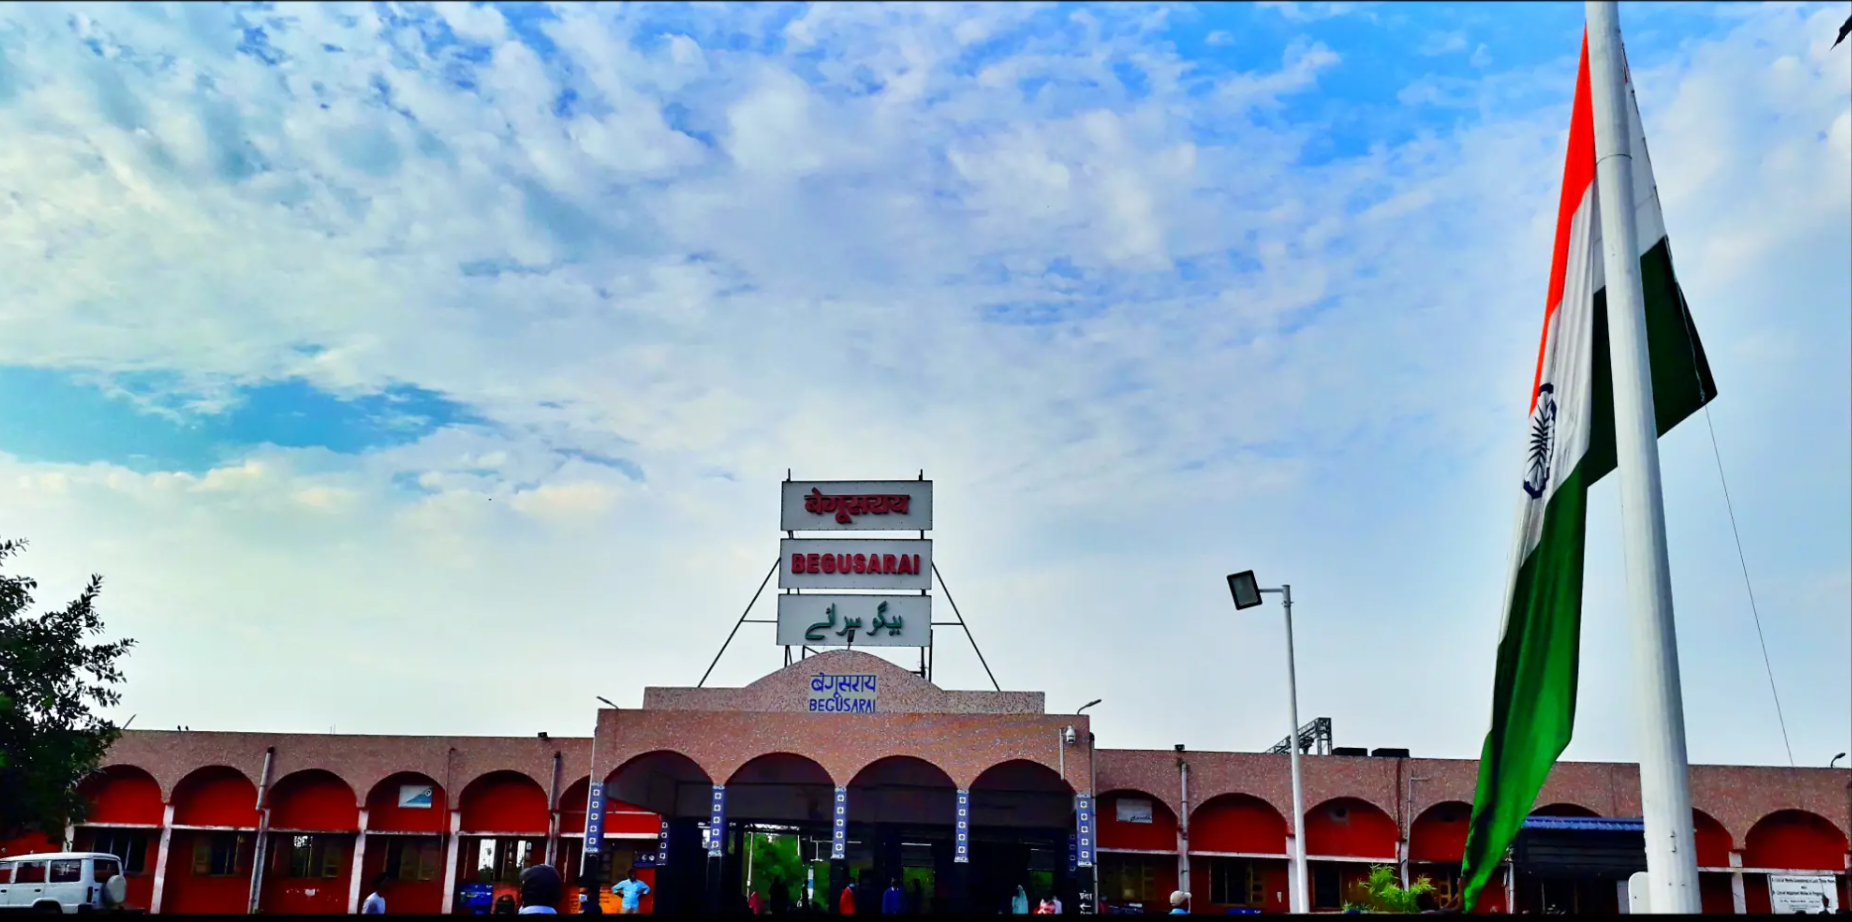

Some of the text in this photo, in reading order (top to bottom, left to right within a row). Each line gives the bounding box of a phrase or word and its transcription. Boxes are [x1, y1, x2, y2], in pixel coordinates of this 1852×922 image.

[804, 487, 911, 524] बेगूसराय
[791, 553, 920, 575] BEGUSARAI
[810, 672, 877, 699] बेगूसराय
[809, 698, 876, 713] BEGUSARAI
